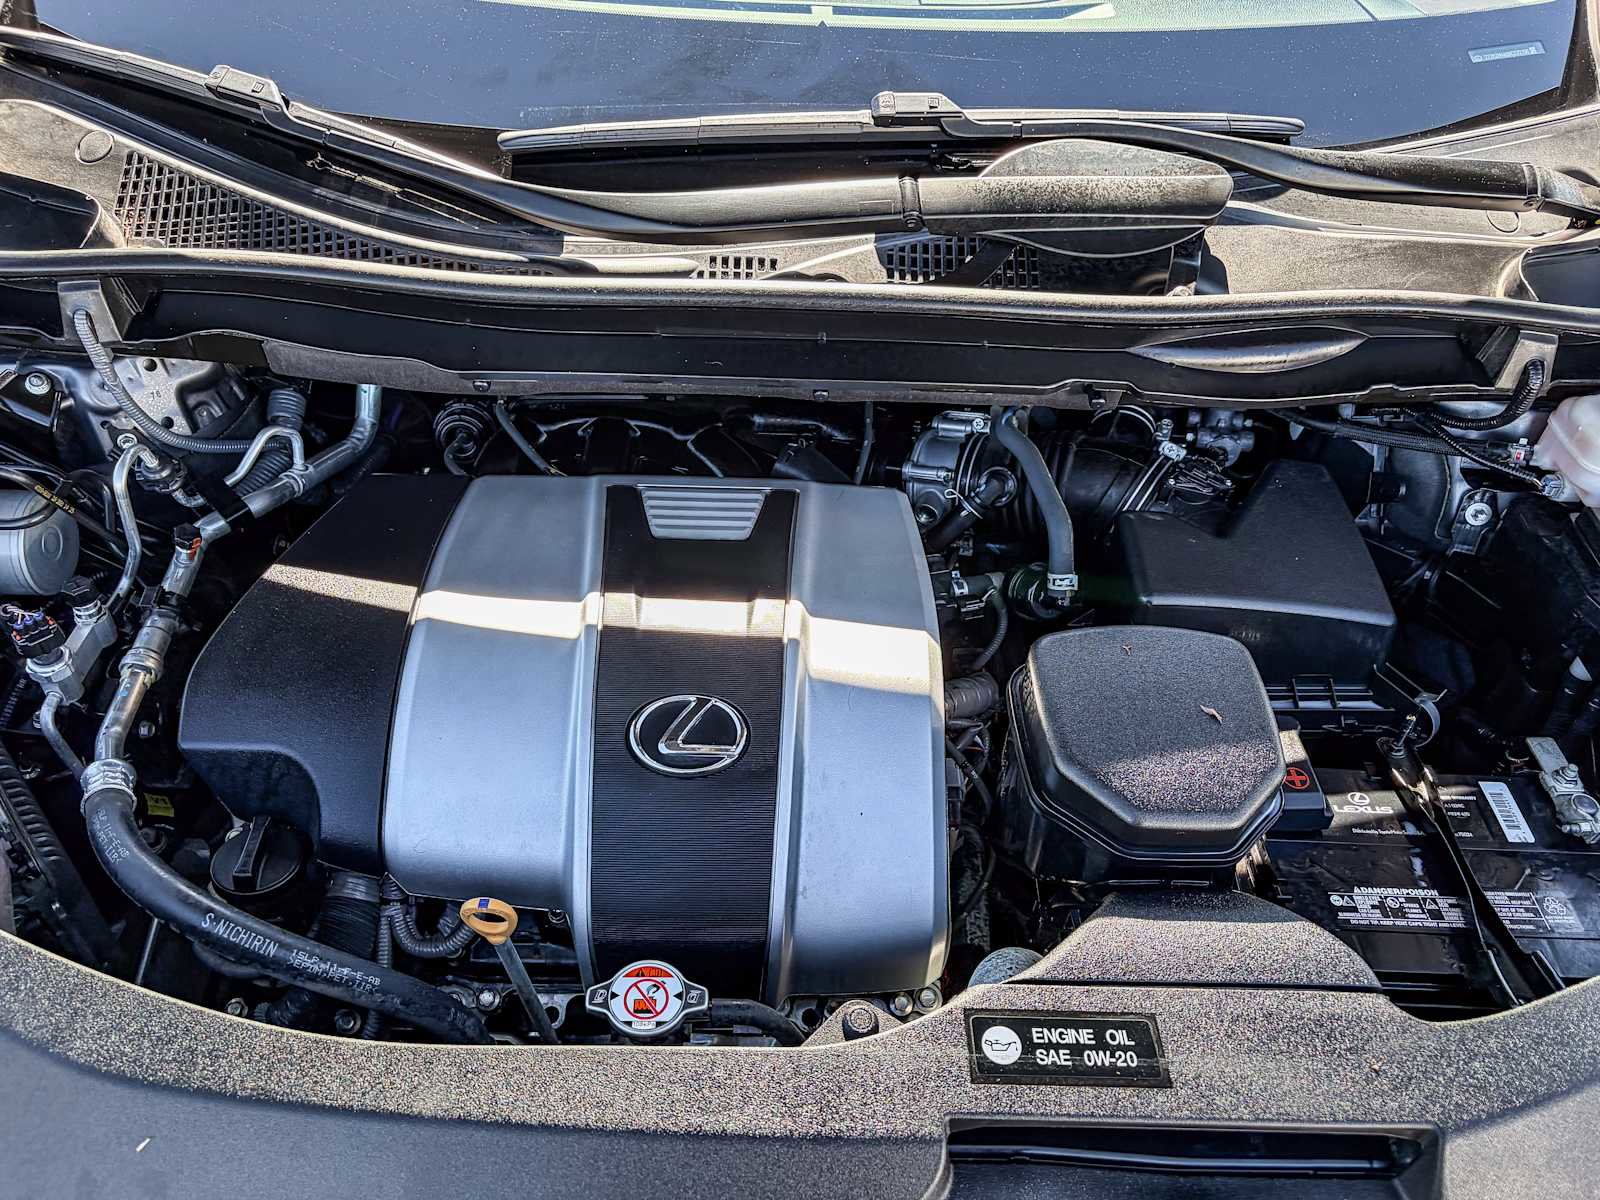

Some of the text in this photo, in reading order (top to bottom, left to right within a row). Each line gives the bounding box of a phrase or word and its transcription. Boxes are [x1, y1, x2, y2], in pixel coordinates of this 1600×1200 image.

[1332, 804, 1394, 814] LEXUS
[1359, 887, 1439, 896] DANGER/POISON
[1031, 1027, 1135, 1045] ENGINE OIL
[1036, 1049, 1138, 1067] SAE 0W-20
